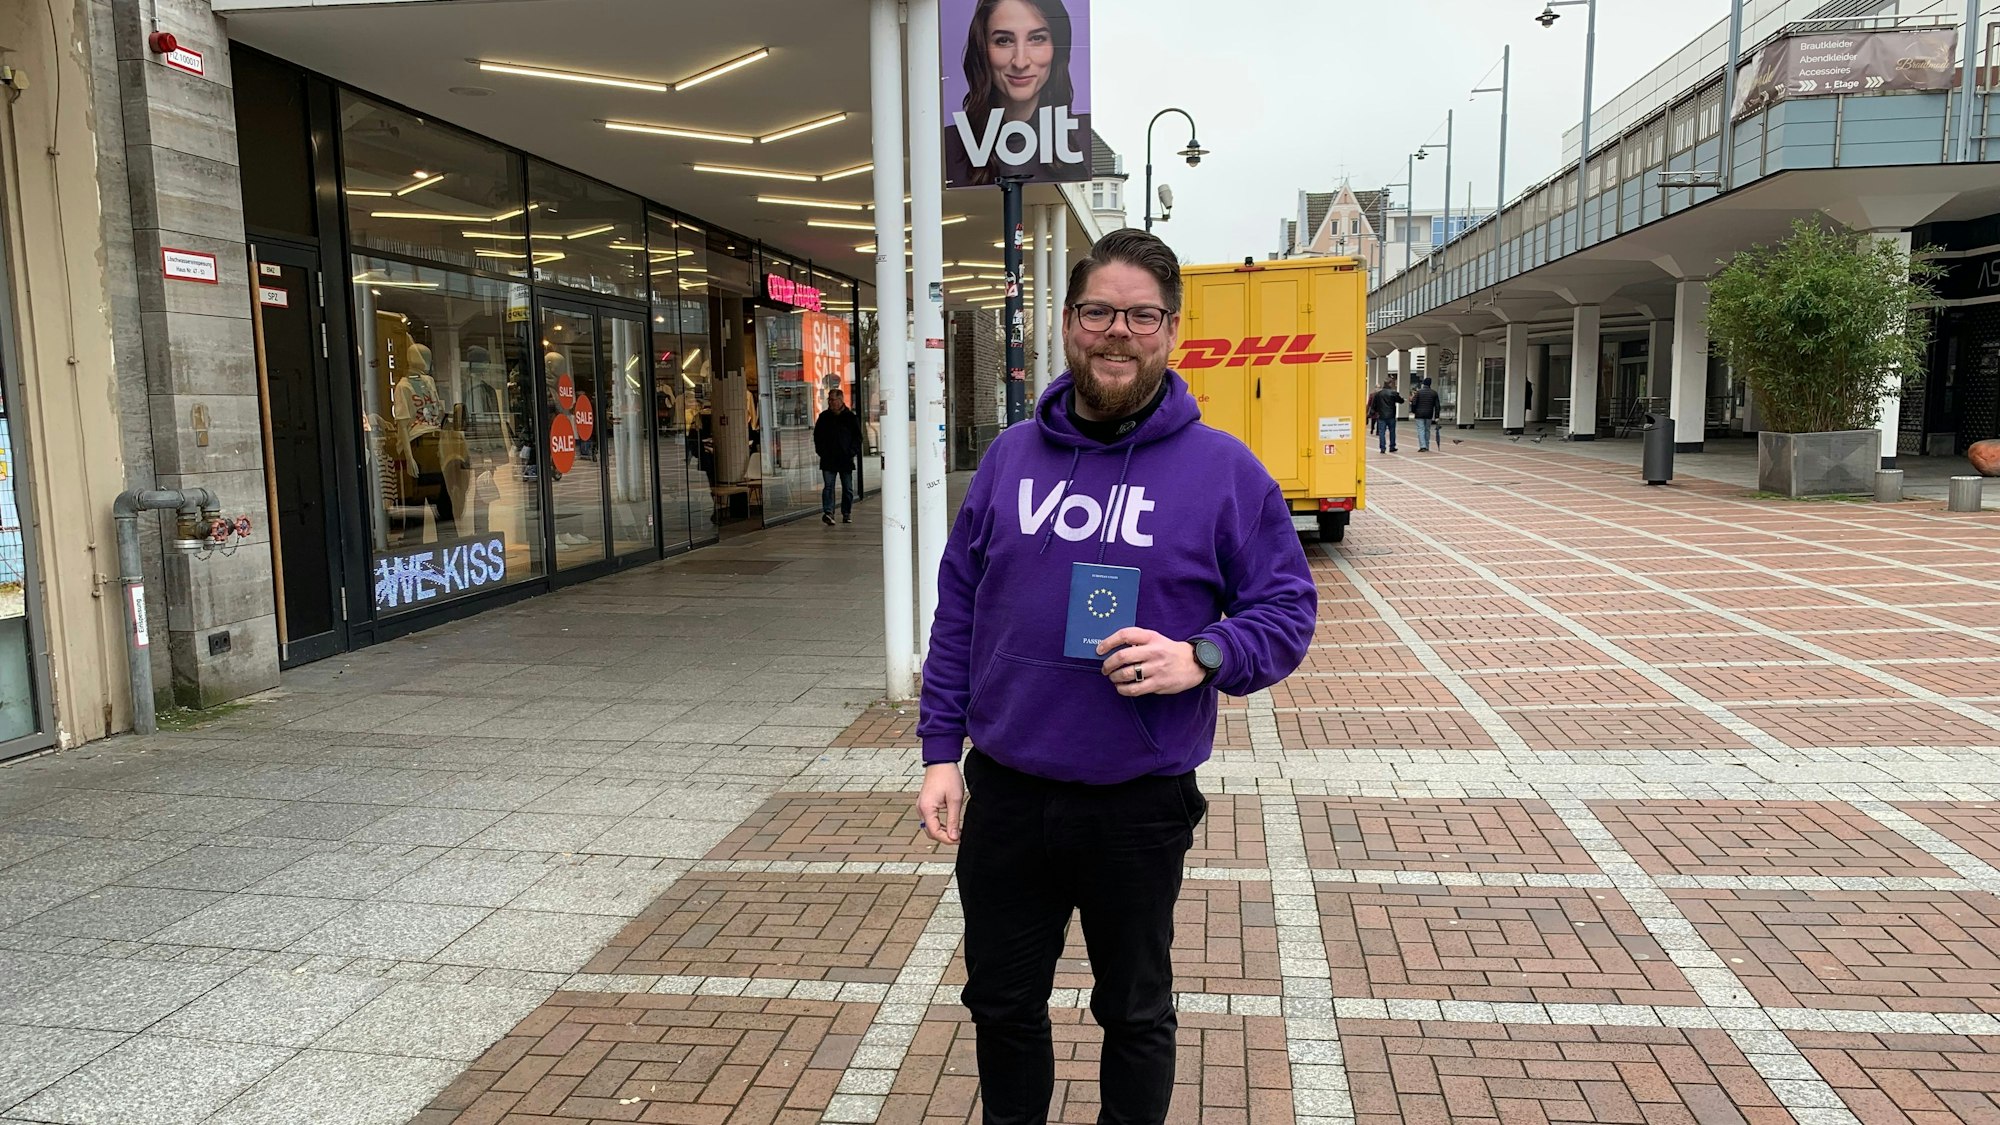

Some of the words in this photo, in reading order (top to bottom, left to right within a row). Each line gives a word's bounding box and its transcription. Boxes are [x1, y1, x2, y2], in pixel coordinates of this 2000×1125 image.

[1800, 40, 1854, 51] Brautkleider
[1799, 53, 1858, 64] Abendkleider
[1798, 67, 1851, 77] Accessoires
[1833, 80, 1860, 90] Etage
[952, 105, 1084, 168] Volt
[267, 292, 278, 302] SPZ
[814, 320, 841, 359] SALE
[1177, 334, 1325, 369] DHL
[559, 386, 574, 397] SALE
[575, 411, 594, 425] SALE
[552, 435, 575, 453] SALE
[1018, 478, 1156, 547] Volt
[443, 539, 505, 594] KISS
